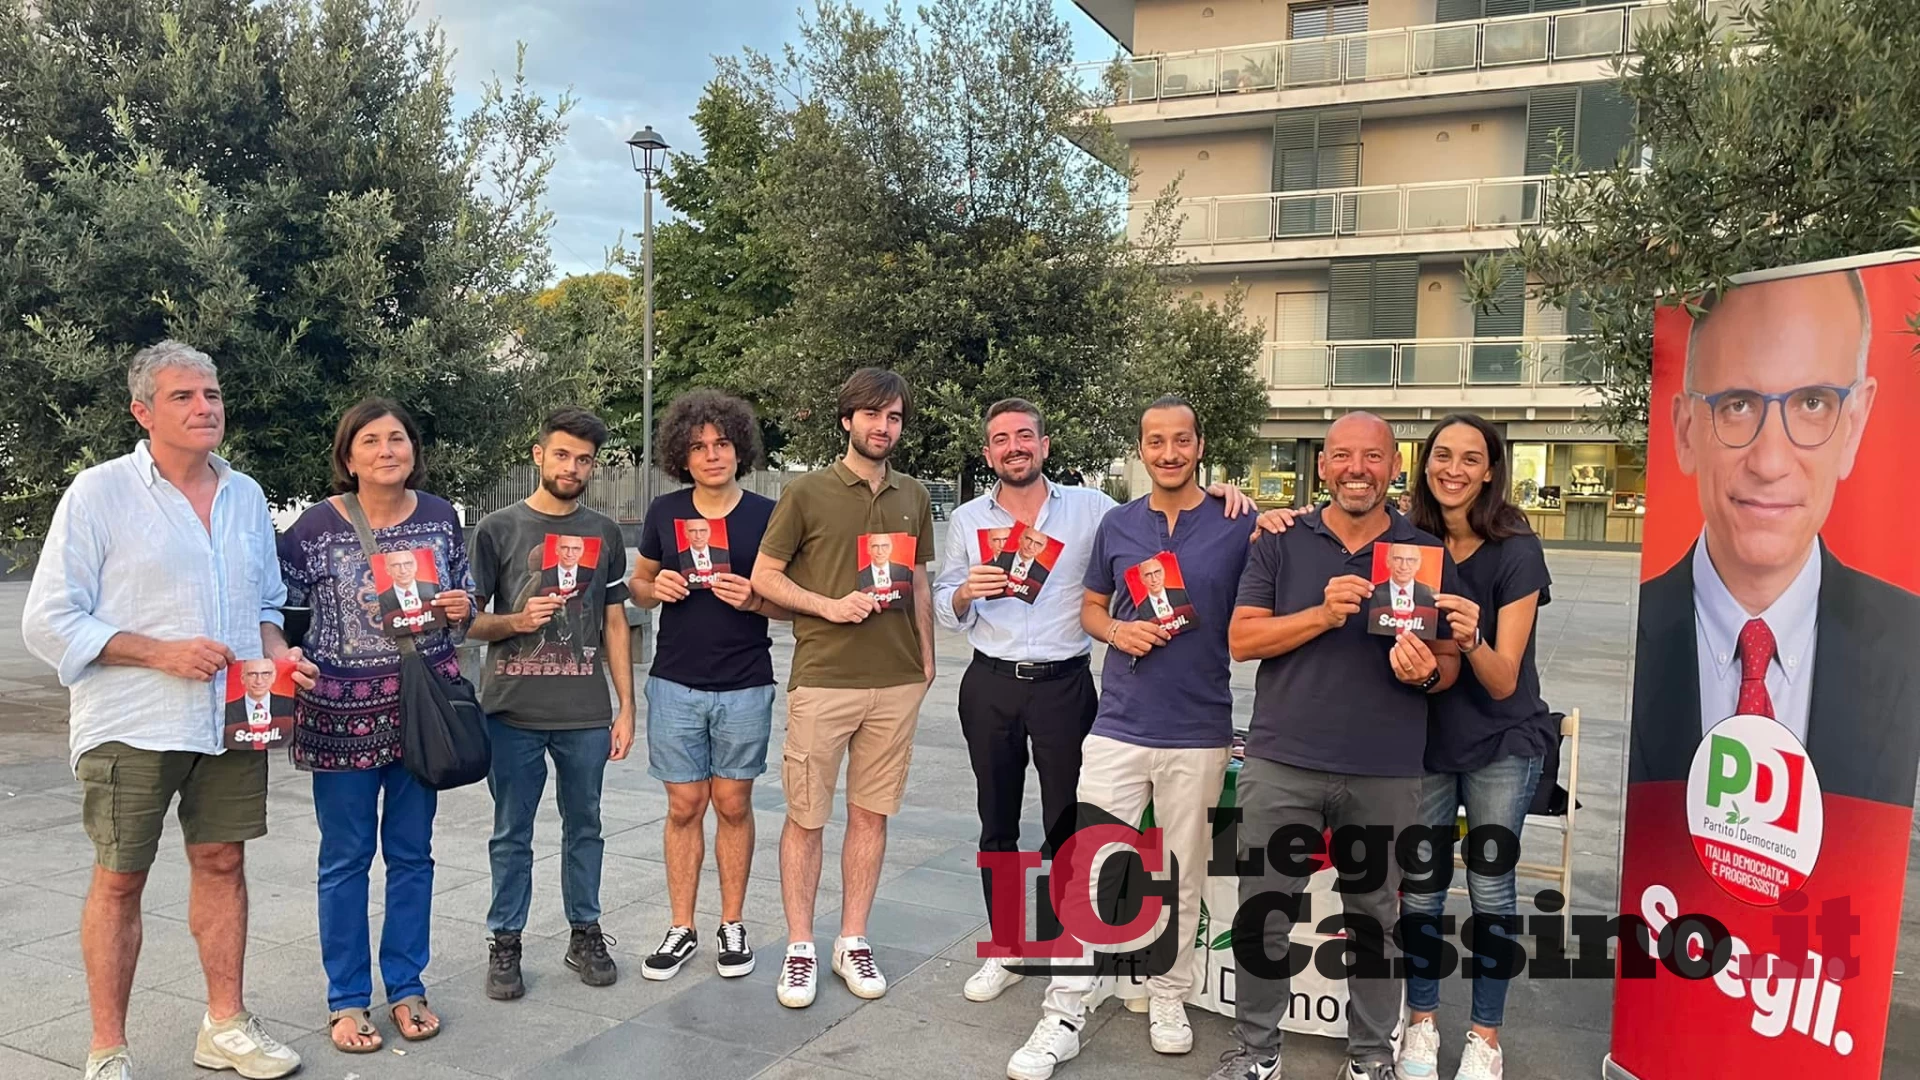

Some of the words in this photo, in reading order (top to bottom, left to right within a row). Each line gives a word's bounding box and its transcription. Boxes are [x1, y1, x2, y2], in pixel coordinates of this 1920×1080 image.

[392, 610, 436, 628] Scegli.
[1378, 613, 1425, 631] Scegli.
[495, 659, 594, 676] JORDAN
[234, 727, 282, 744] Scegli.
[1705, 733, 1805, 834] PD
[1703, 816, 1735, 838] Partito
[1739, 828, 1797, 860] Democratico
[1705, 843, 1732, 865] ITALIA
[1732, 853, 1790, 887] DEMOCRATICA
[1711, 862, 1719, 876] E
[1719, 865, 1780, 900] PROGRESSISTA
[1636, 884, 1854, 1056] Scegli.
